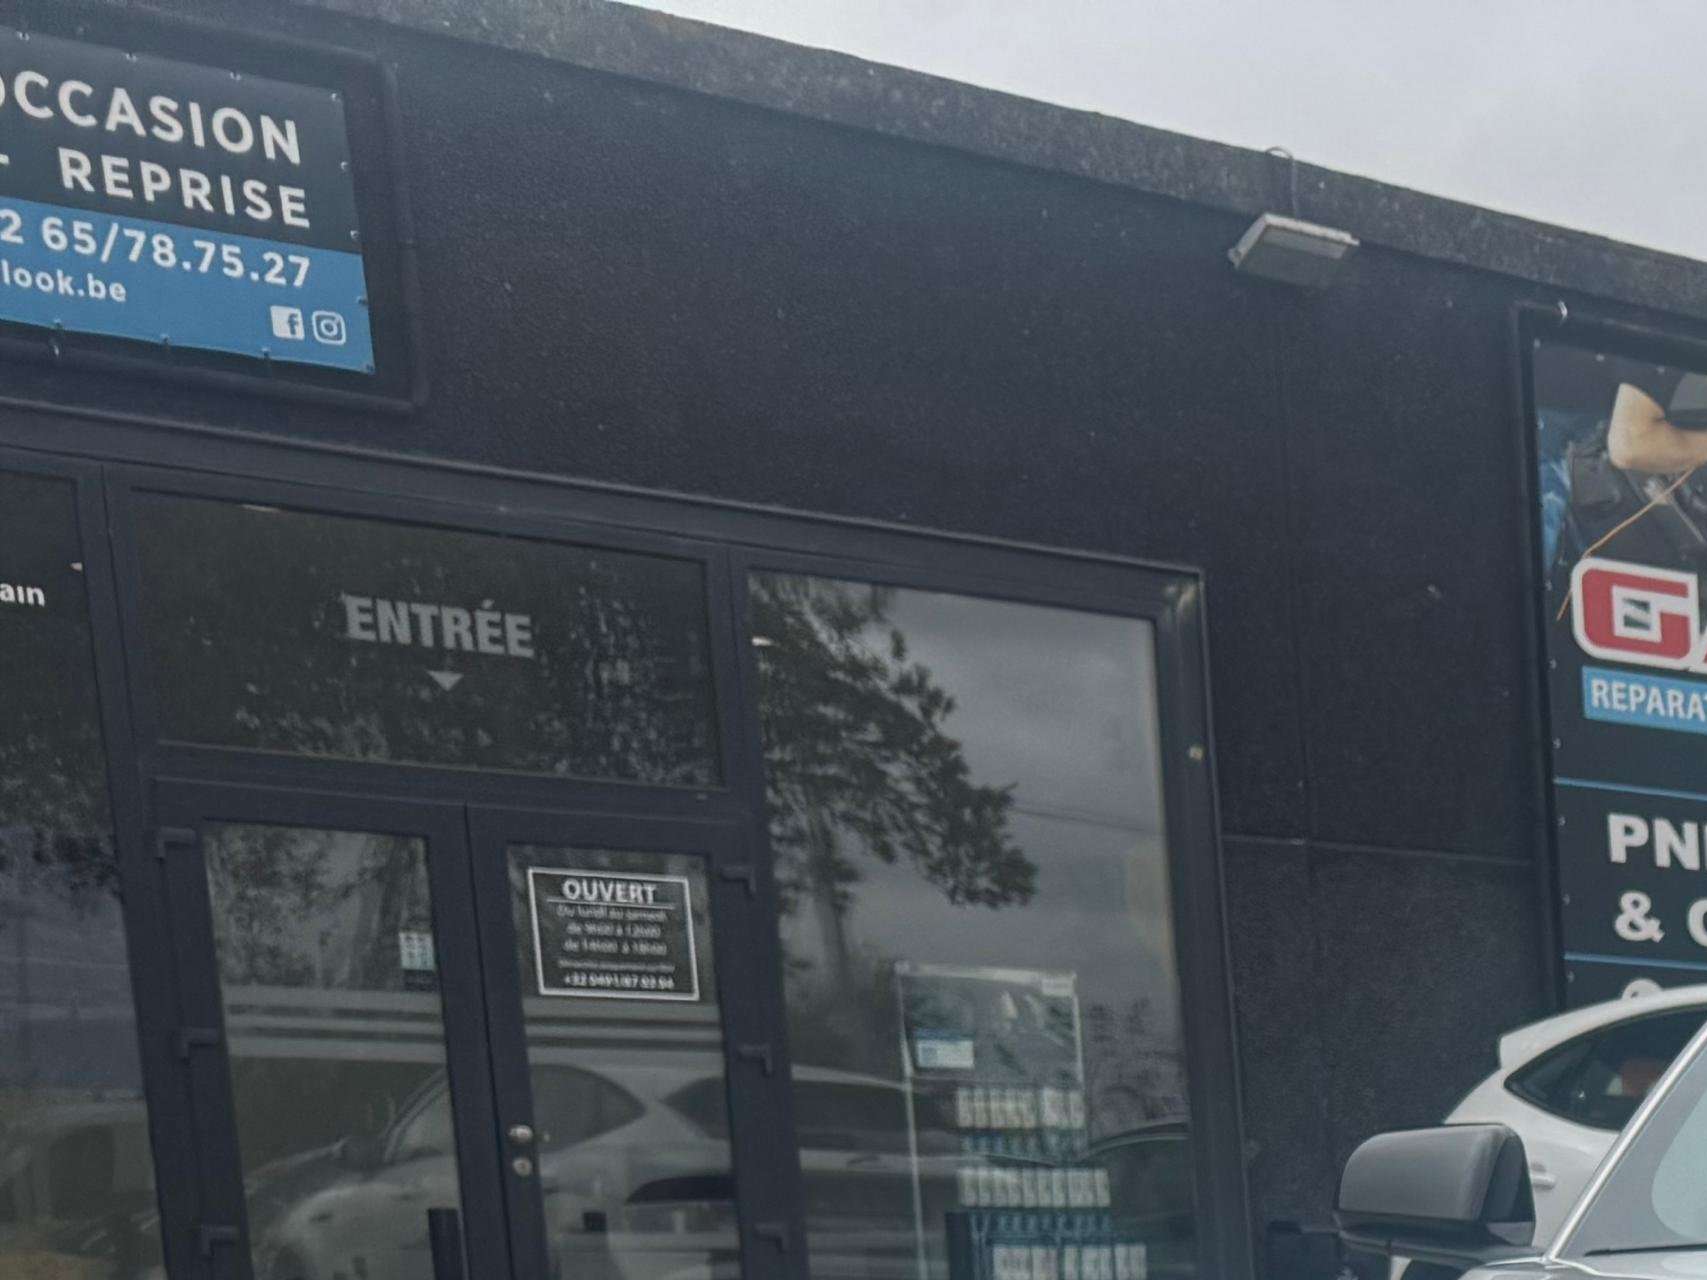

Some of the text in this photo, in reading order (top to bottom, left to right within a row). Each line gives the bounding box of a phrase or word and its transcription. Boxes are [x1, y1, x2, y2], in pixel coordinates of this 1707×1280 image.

[0, 70, 301, 166] CCASION
[58, 147, 311, 229] REPRISE
[41, 215, 311, 289] 65/78.75.27
[340, 592, 535, 659] ENTRÉE
[561, 878, 657, 904] OUVERT
[1614, 890, 1666, 943] &
